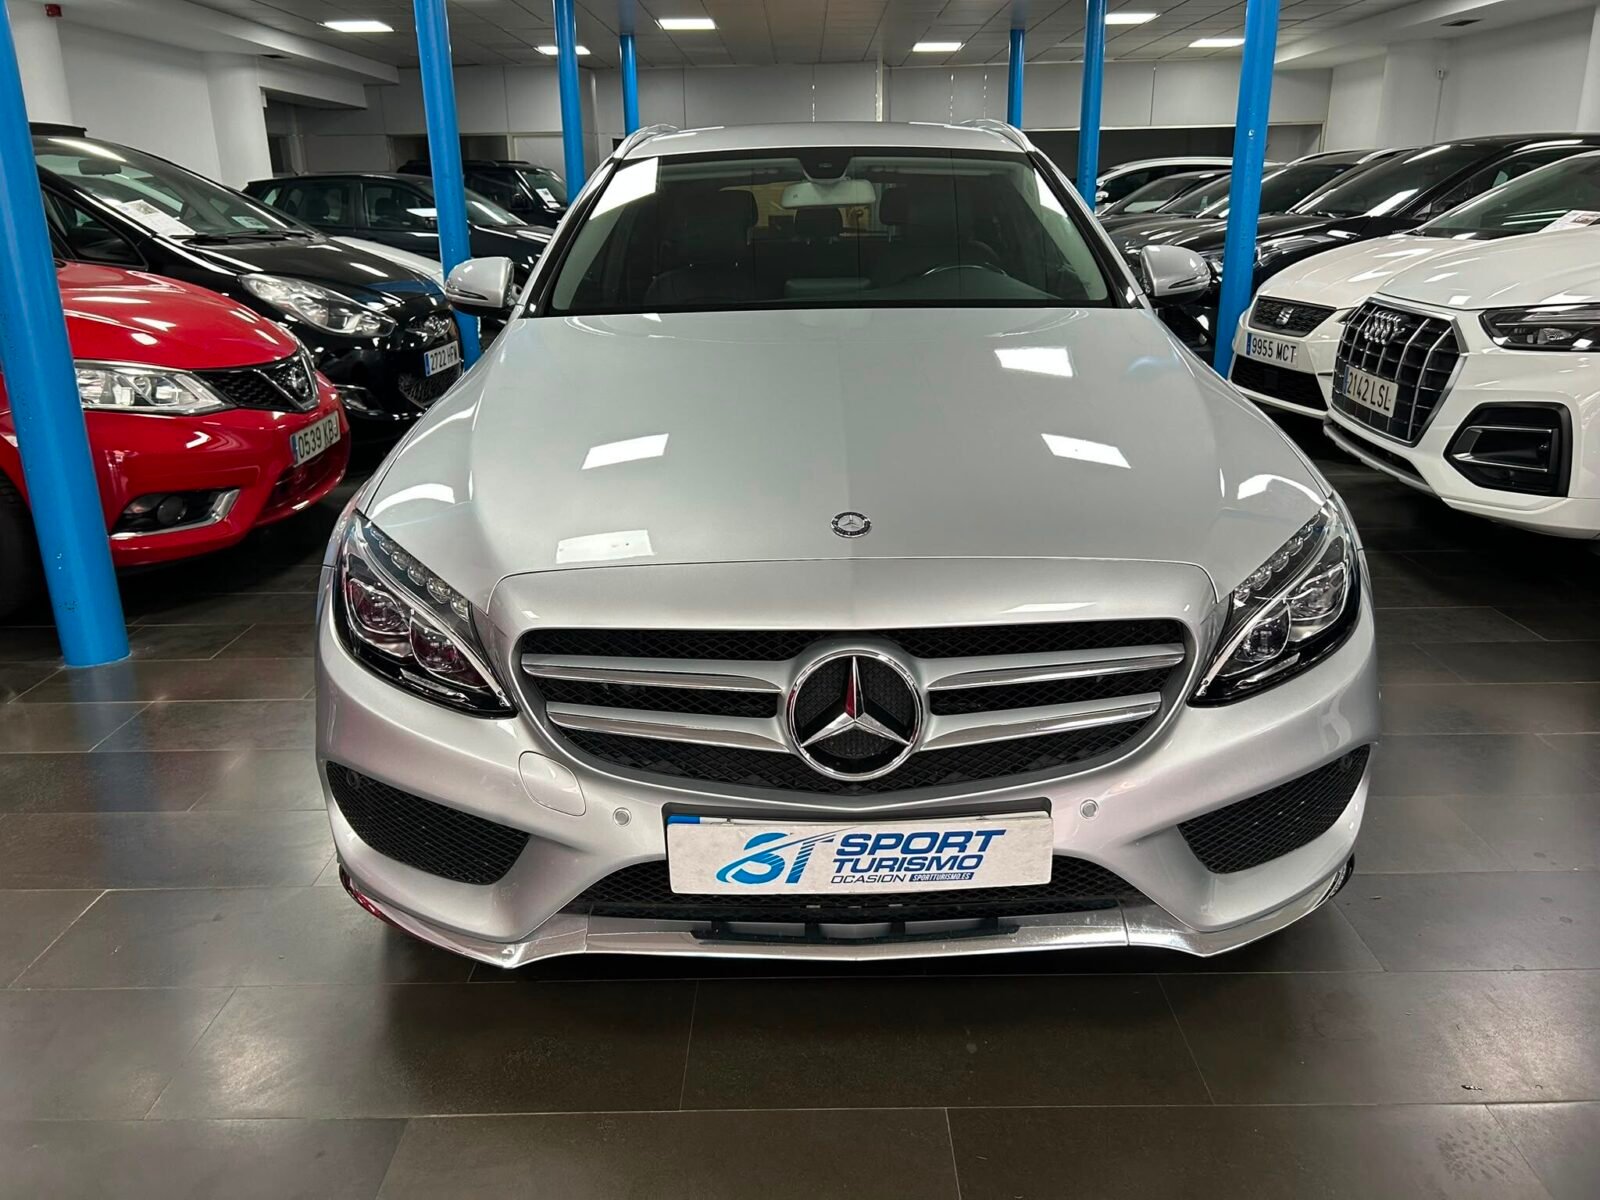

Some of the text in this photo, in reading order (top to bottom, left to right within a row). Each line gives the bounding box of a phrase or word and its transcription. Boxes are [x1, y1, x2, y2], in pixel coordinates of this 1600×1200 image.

[430, 350, 447, 371] 2722
[1251, 337, 1297, 363] 9955 MCT
[1347, 371, 1390, 411] 2142 LSL
[298, 426, 322, 458] 0539
[836, 829, 1006, 856] SPORT
[832, 854, 984, 874] TURISMO
[830, 872, 971, 884] OCASION SPORTTURISMO.ES
